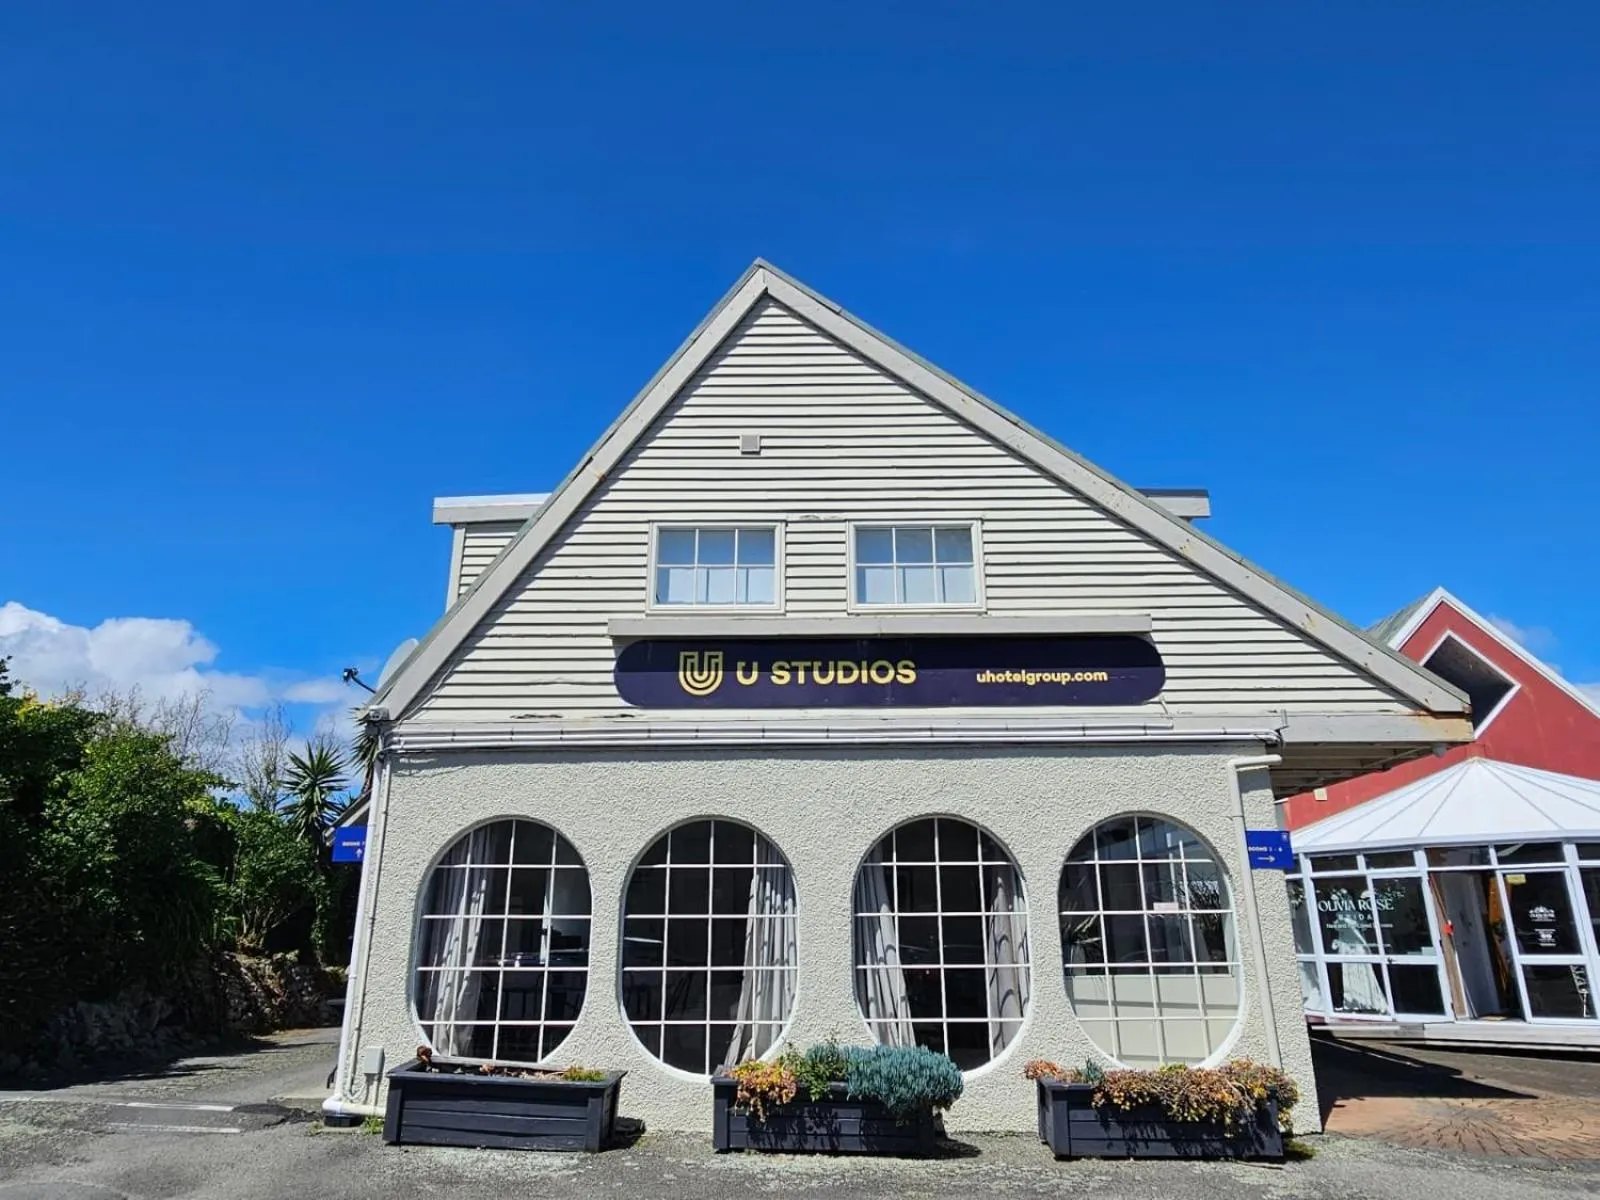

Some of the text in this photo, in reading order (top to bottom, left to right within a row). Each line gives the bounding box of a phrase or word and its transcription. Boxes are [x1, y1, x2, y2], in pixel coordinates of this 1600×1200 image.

[736, 660, 917, 685] U STUDIOS
[976, 669, 1108, 685] uhotelgroup.com
[1318, 900, 1357, 912] OLIVIA
